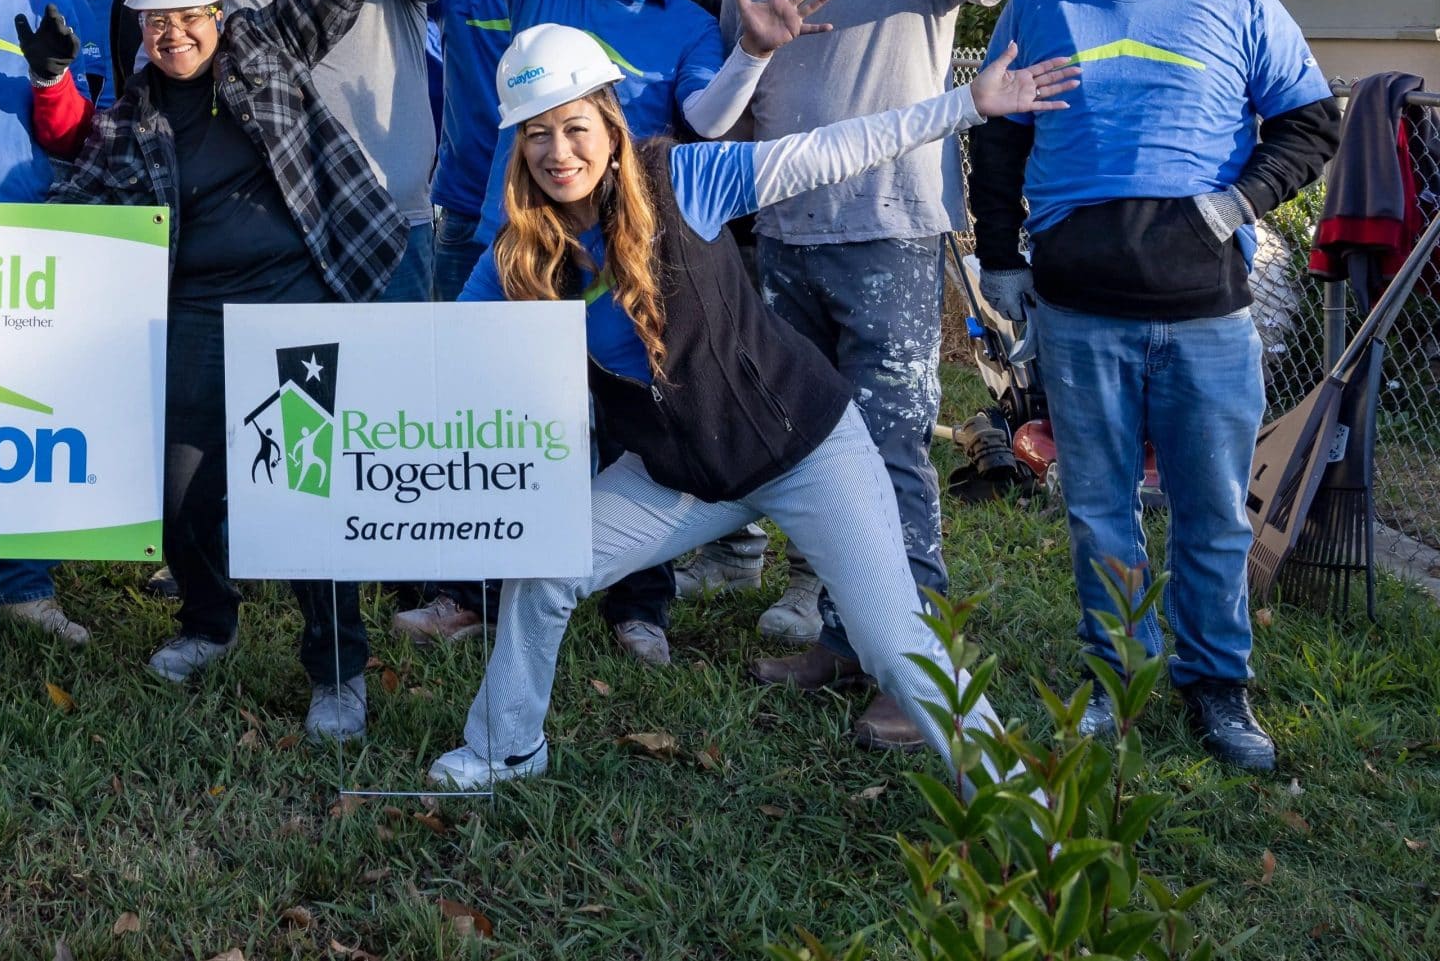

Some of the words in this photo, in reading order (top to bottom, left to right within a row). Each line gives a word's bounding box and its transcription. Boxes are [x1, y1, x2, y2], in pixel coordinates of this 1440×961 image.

[507, 66, 545, 88] Clayton
[342, 409, 571, 461] Rebuilding
[344, 516, 524, 541] Sacramento
